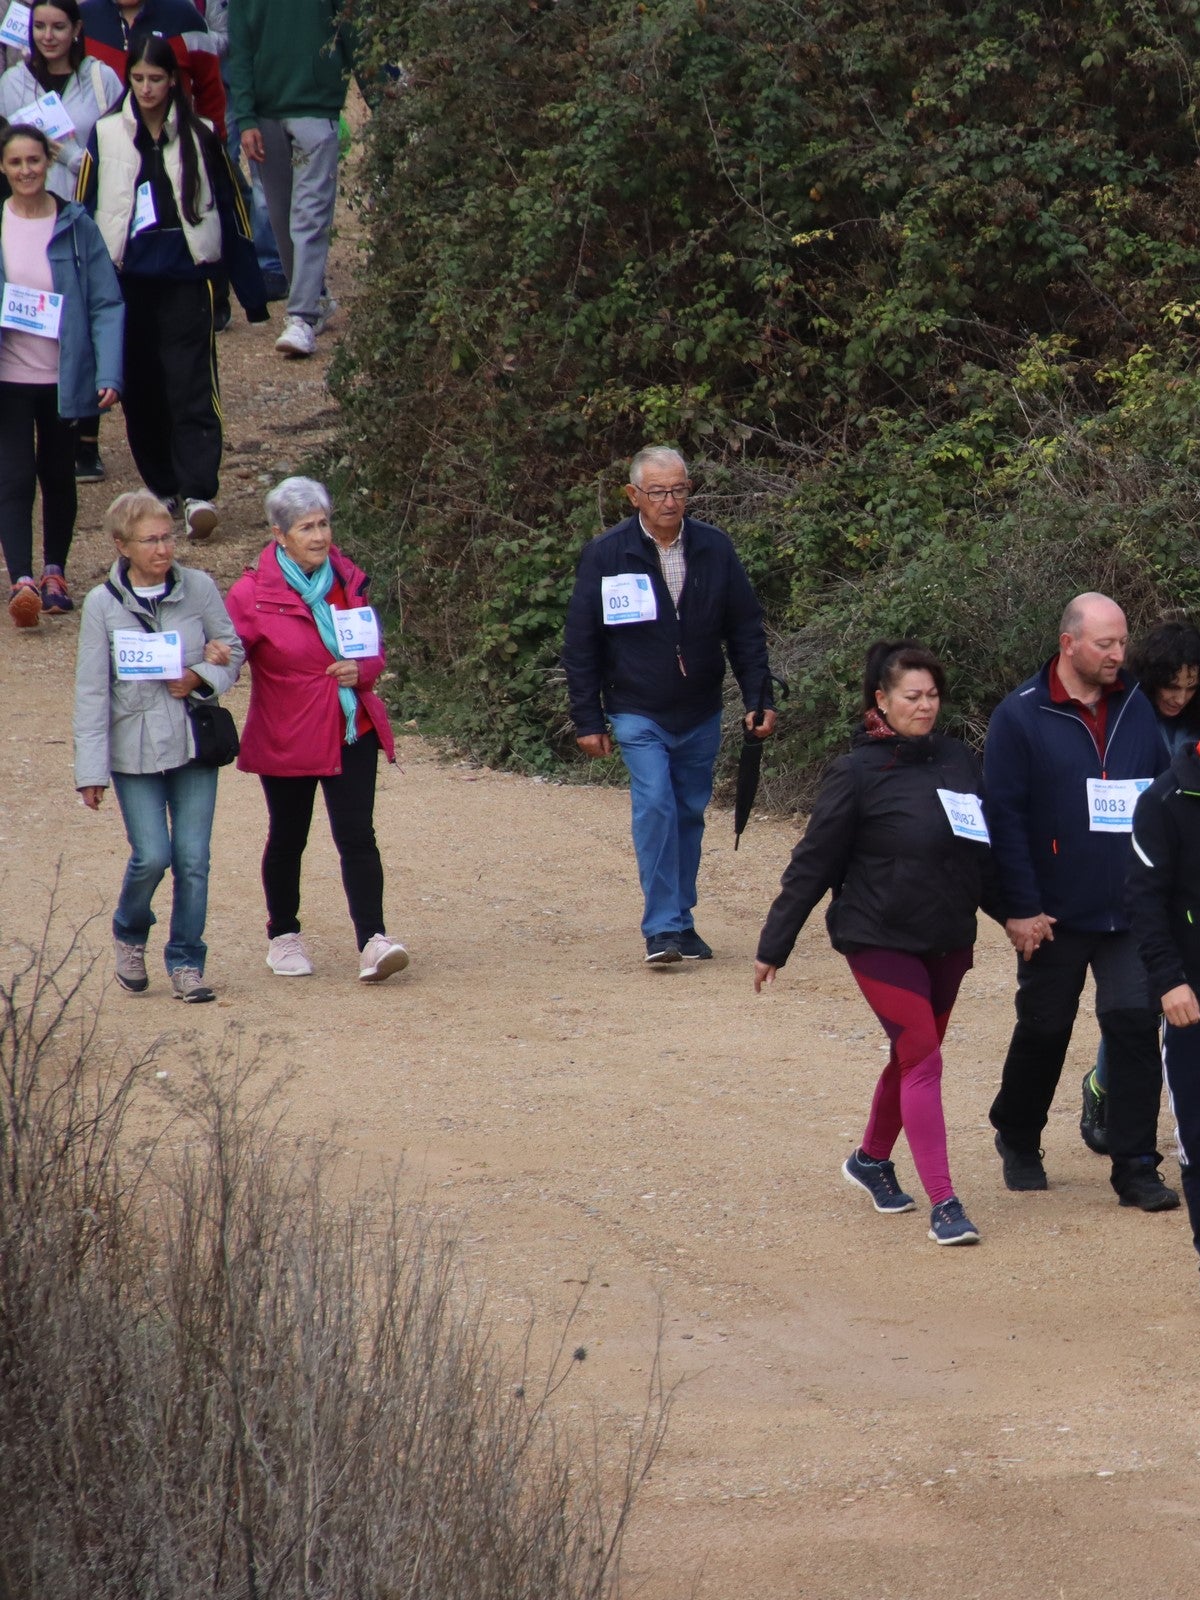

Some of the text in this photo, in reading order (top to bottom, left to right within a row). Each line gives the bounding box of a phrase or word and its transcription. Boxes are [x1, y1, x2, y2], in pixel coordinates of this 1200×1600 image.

[9, 301, 36, 317] 0413
[119, 650, 153, 662] 0325
[1095, 798, 1125, 812] 0083
[951, 810, 976, 825] 0082
